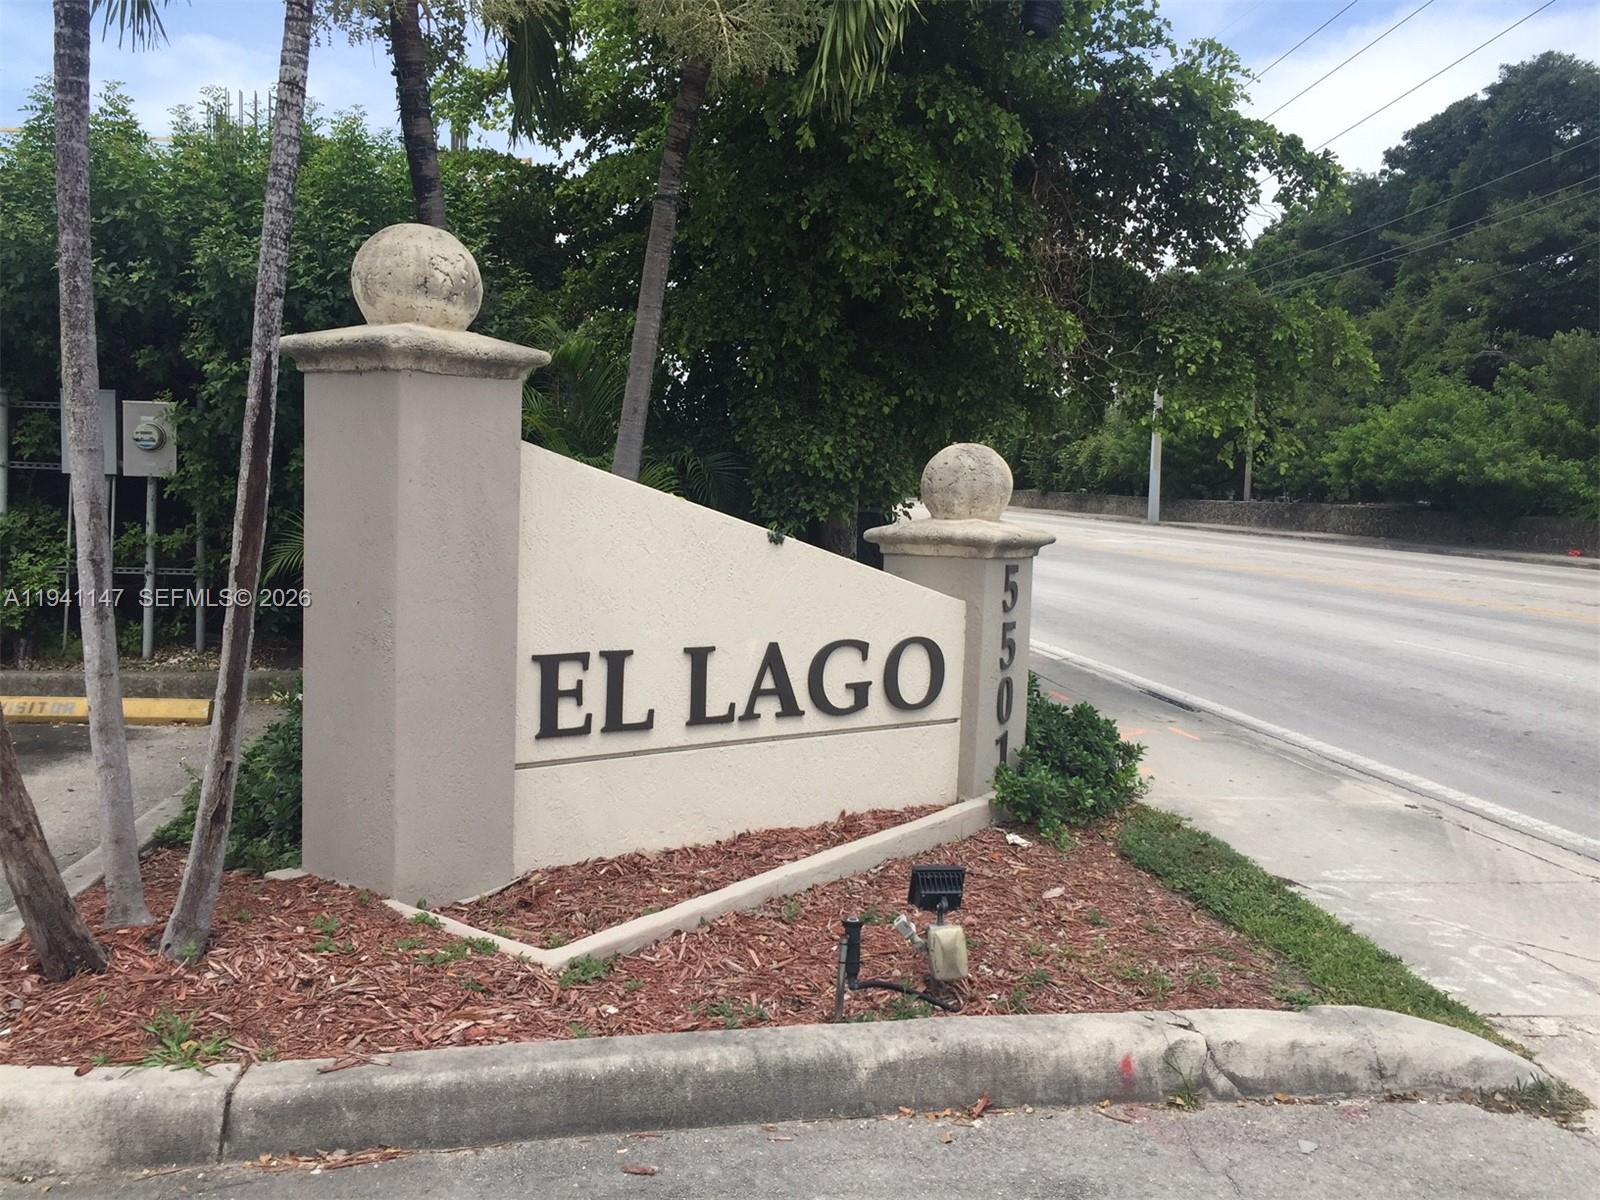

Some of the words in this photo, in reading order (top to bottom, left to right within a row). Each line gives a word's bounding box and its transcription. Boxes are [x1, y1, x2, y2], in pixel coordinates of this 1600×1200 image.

[531, 649, 655, 739] EL
[683, 636, 946, 726] LAGO
[995, 564, 1020, 763] 5501
